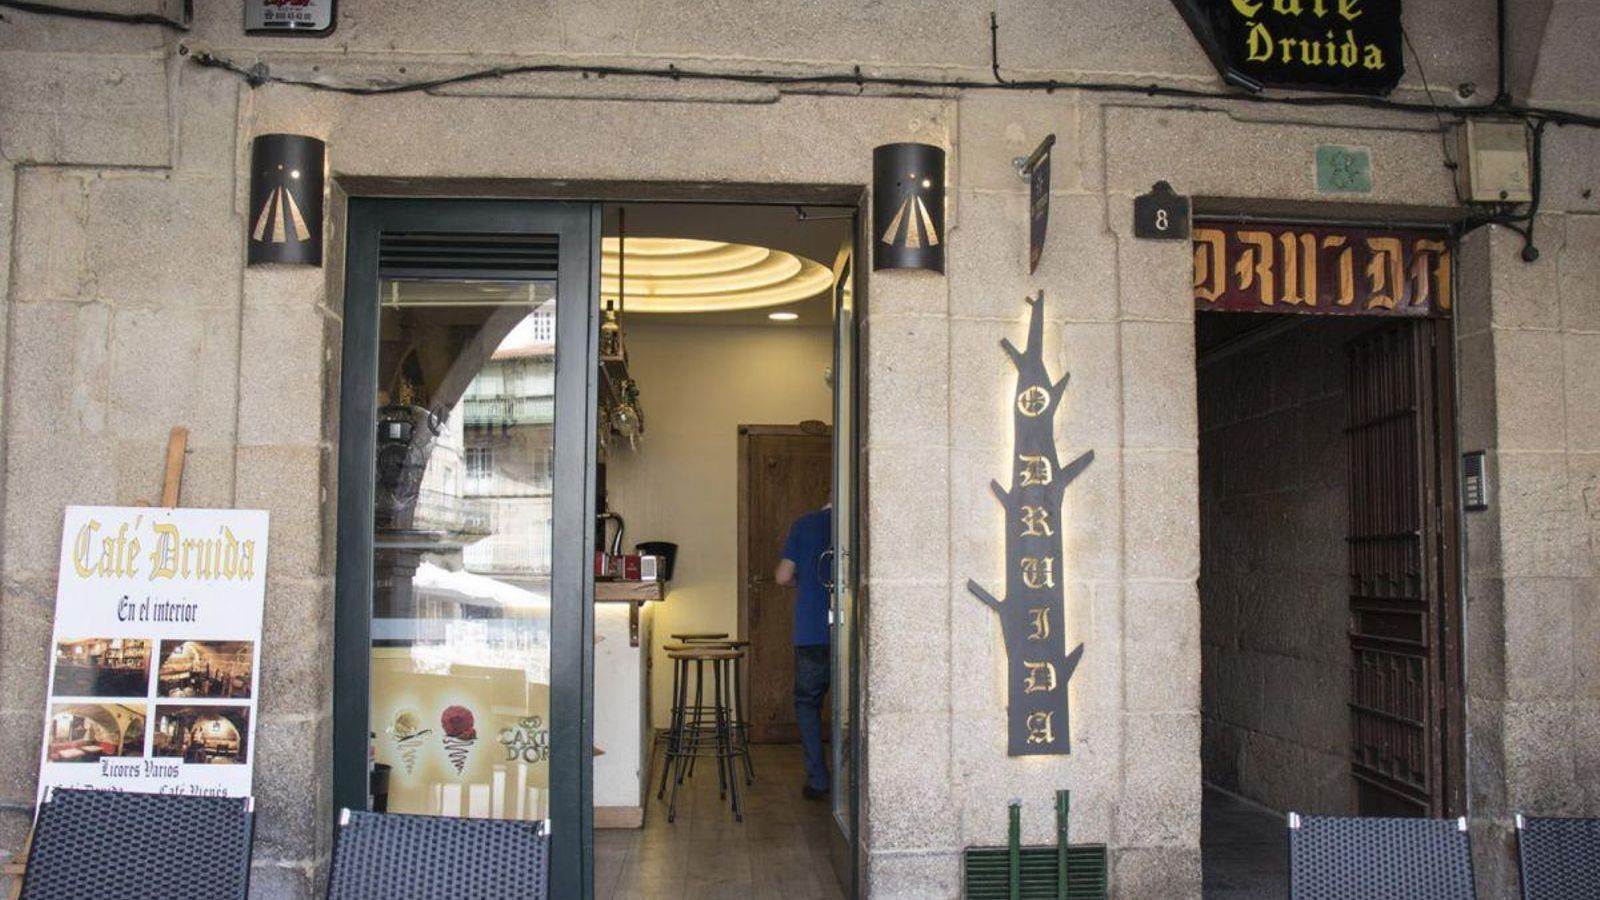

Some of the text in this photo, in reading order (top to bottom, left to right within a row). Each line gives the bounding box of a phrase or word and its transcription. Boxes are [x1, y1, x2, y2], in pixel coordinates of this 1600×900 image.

[1246, 22, 1385, 70] Druida
[1155, 209, 1169, 231] 8
[73, 514, 256, 582] Café Druida
[117, 595, 198, 622] En el interior
[499, 728, 548, 747] CART
[101, 759, 141, 778] Licores
